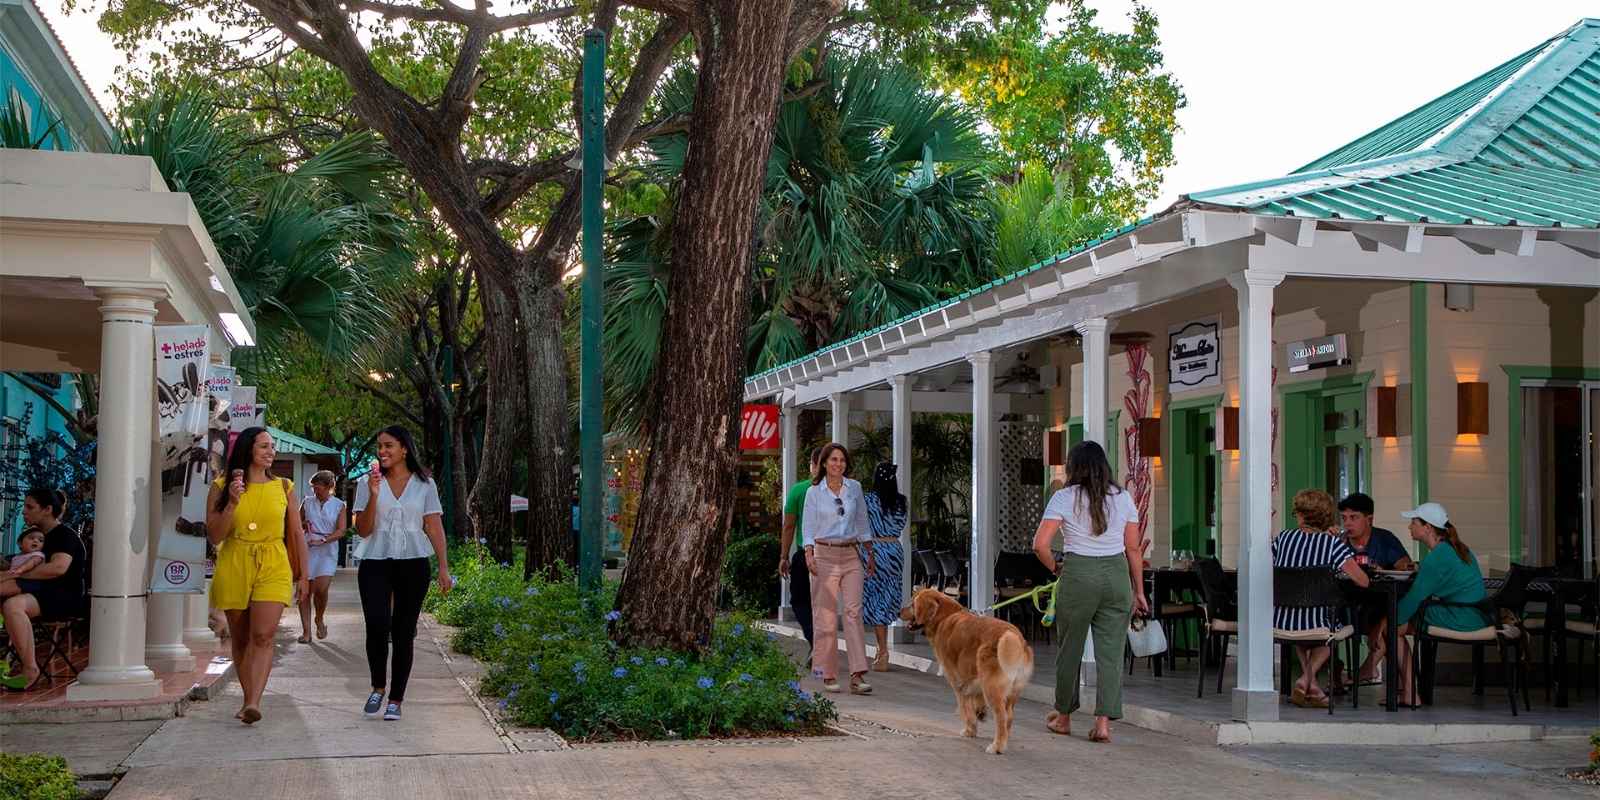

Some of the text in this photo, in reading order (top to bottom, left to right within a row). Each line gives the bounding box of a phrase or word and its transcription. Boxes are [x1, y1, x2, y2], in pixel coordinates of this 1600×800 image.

[173, 338, 206, 352] helado
[208, 376, 231, 385] elado
[740, 411, 777, 446] illy
